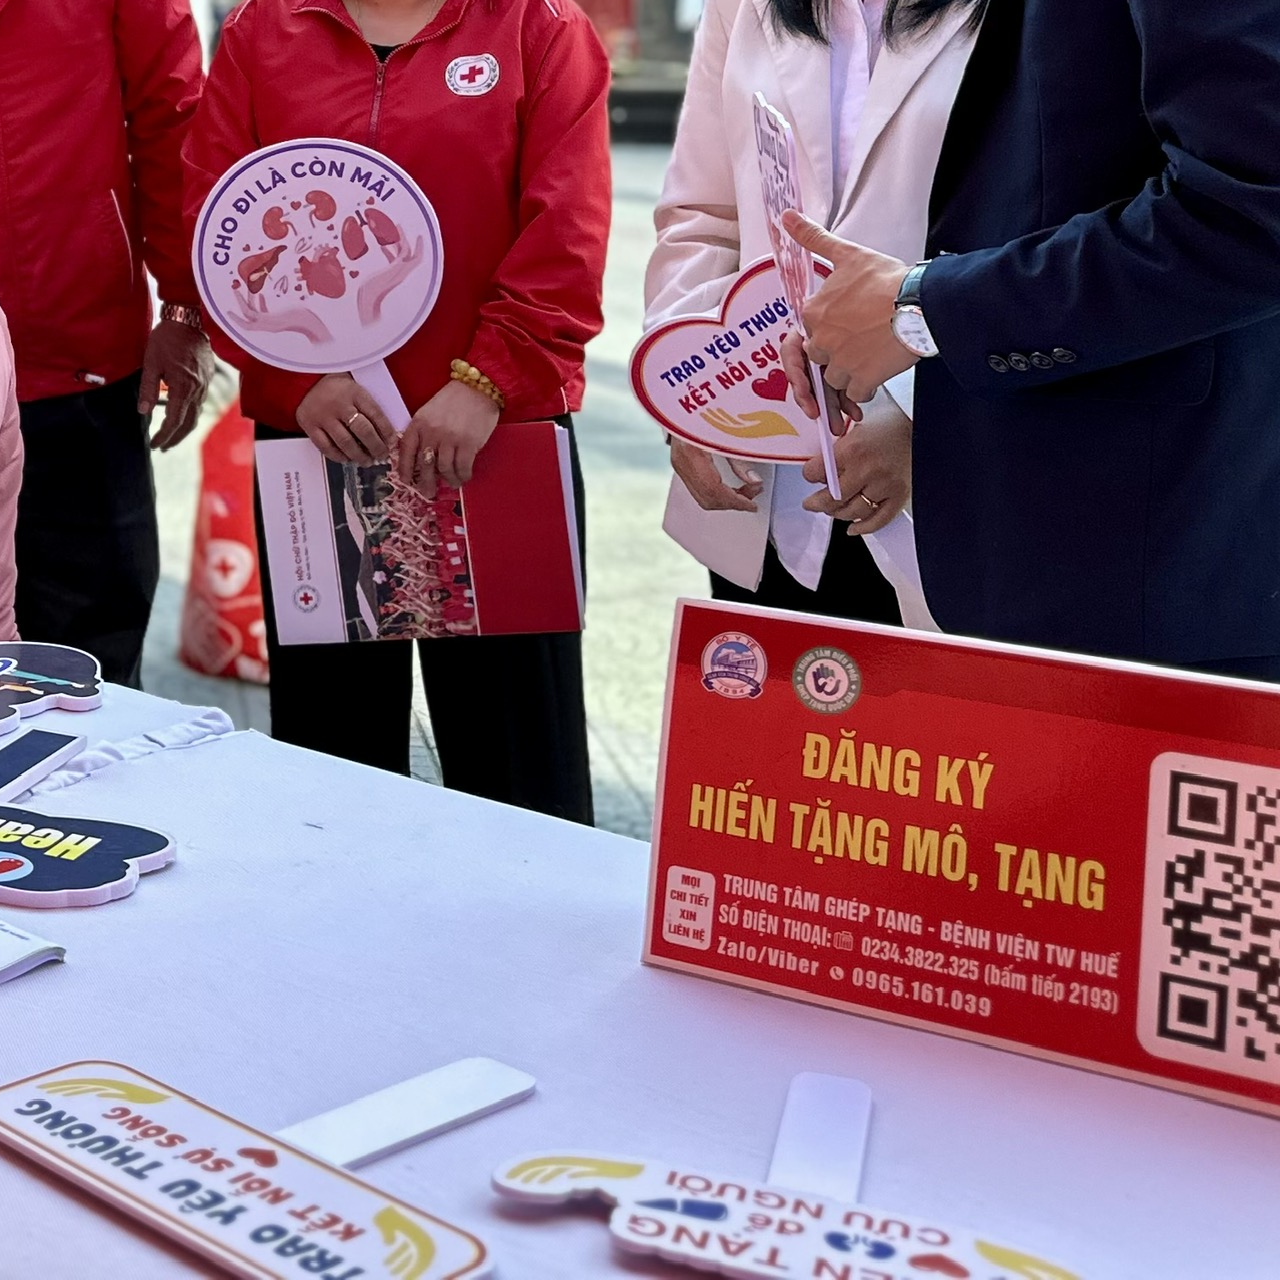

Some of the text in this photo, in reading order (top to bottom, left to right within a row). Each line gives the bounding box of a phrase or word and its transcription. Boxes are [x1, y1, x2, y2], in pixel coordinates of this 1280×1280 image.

[212, 156, 396, 266] CHO ĐI LÀ CÒN MÃI
[660, 353, 706, 388] TRAO
[705, 329, 741, 359] YÊU
[677, 343, 782, 415] KẾT NỐI SỰ
[801, 728, 995, 810] ĐĂNG KÝ
[681, 872, 702, 889] MỌI
[688, 779, 1106, 910] HIẾN TẶNG MÔ, TẠNG
[667, 919, 706, 944] LIÊN HỆ
[670, 888, 710, 908] CHI TIẾT
[679, 907, 697, 922] XIN
[722, 873, 778, 904] TRUNG
[782, 881, 820, 913] TÂM
[824, 891, 871, 924] GHÉP
[875, 904, 923, 937] TẠNG
[940, 915, 991, 953] BỆNH
[995, 928, 1041, 963] VIỆN
[1043, 940, 1076, 968] TW
[1080, 947, 1122, 979] HUẾ
[716, 936, 993, 1018] Zalo/Viber 0965.161.039
[718, 901, 1120, 1016] SỐ ĐIỆN THOẠI: 0234.3822.325 (bấm tiếp 2193)
[13, 1098, 365, 1280] TRAO YÊU THƯƠNG
[100, 1104, 366, 1243] KẾT NỐI SỰ SỐNG
[663, 1168, 952, 1249] CỨU NGƯỜI
[625, 1212, 787, 1270] TẠNG
[743, 1210, 806, 1240] để
